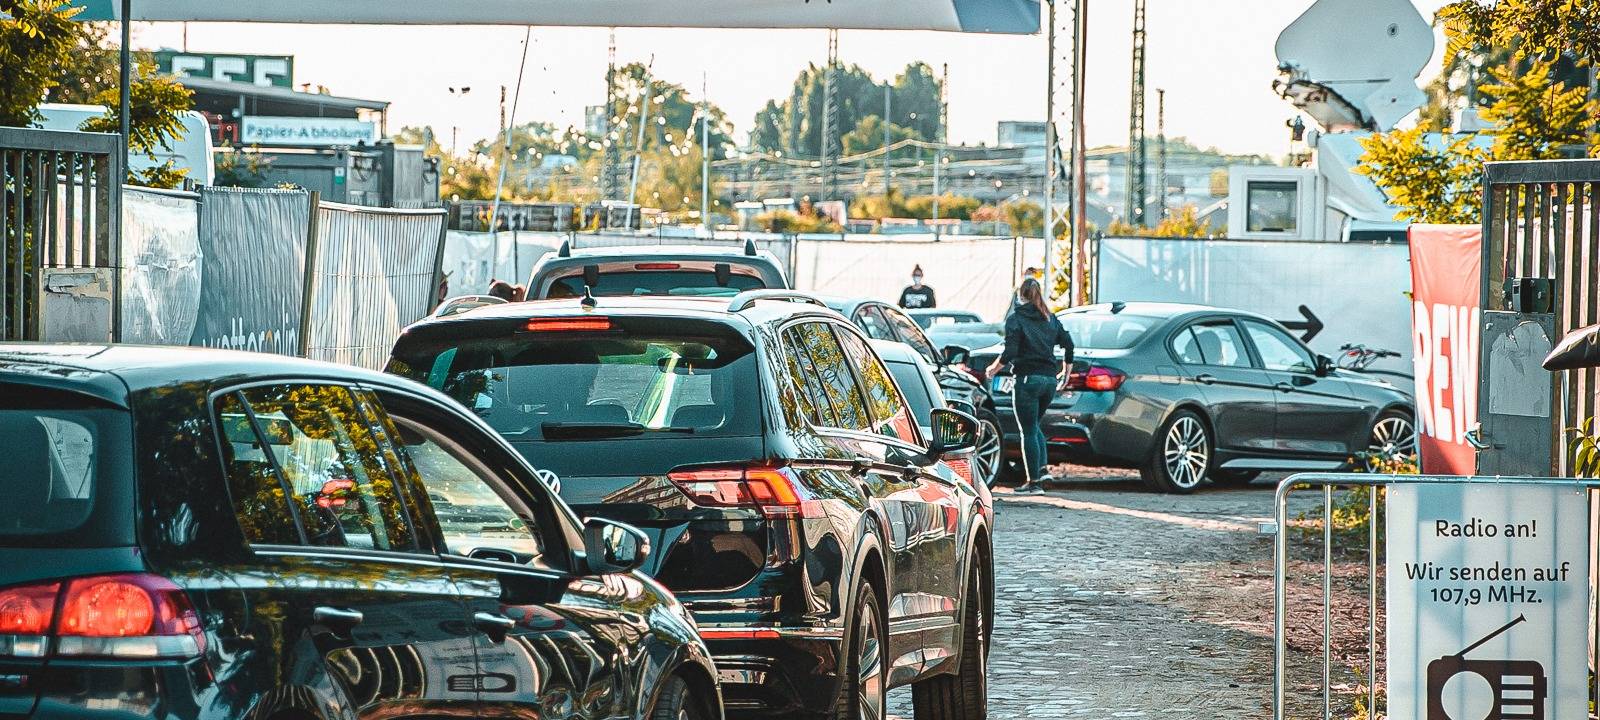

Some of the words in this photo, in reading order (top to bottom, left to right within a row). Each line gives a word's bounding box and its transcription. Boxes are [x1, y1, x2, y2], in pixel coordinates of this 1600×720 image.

[246, 123, 371, 139] Papier-Abholung
[1436, 517, 1498, 538] Radio
[1504, 519, 1537, 538] an!
[1405, 561, 1444, 580] Wir
[1449, 561, 1527, 581] senden
[1533, 561, 1570, 582] auf
[1430, 588, 1482, 606] 107,9
[1488, 585, 1543, 603] MHz.
